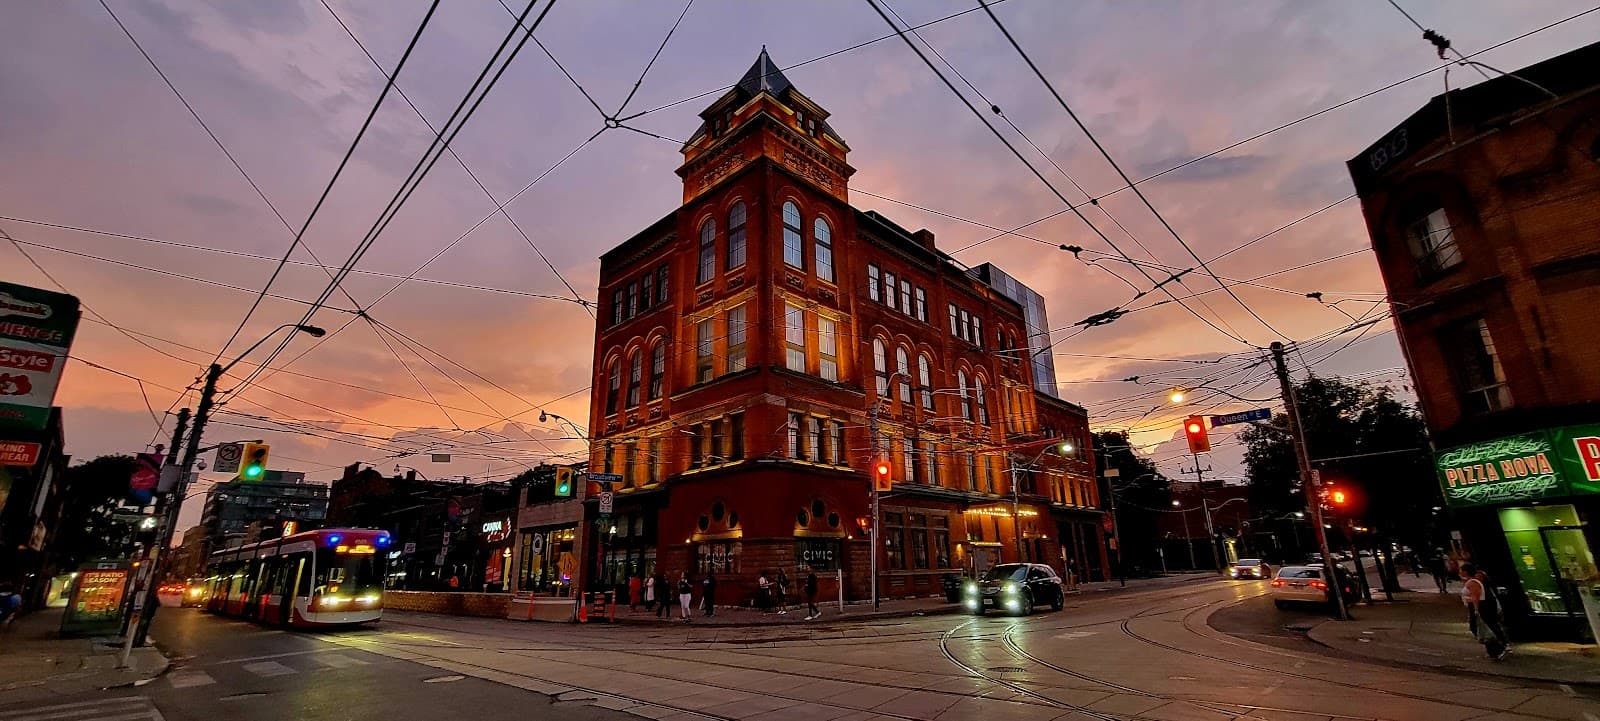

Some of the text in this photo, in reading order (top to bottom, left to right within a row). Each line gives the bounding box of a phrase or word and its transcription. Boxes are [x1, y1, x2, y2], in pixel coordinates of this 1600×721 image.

[1219, 413, 1249, 424] Queen
[1255, 410, 1262, 418] E
[1444, 462, 1500, 488] PIZZA
[1500, 452, 1554, 479] NOVA
[705, 552, 735, 563] CIVIC
[803, 549, 833, 561] CIVIC
